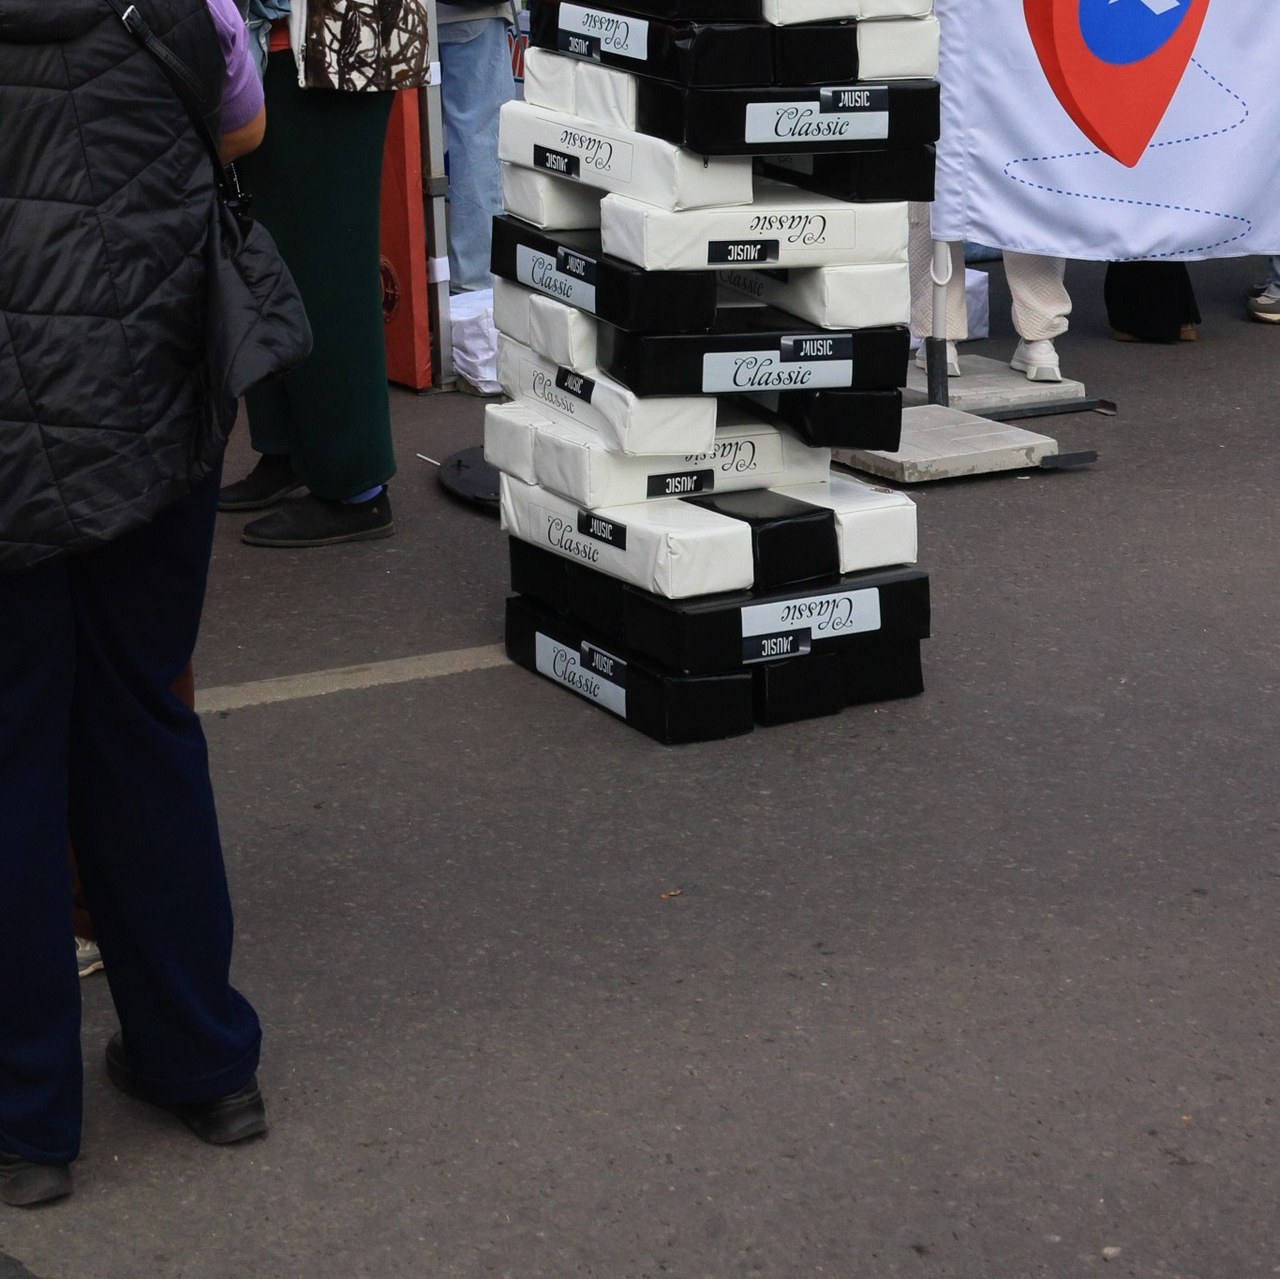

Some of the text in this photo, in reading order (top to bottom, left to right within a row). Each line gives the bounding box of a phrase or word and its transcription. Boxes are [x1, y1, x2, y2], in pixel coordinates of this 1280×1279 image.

[582, 13, 629, 50] Classic
[569, 38, 589, 55] MUSIC
[839, 91, 870, 107] MUSIC
[774, 107, 850, 137] Classic
[546, 153, 568, 172] MUSIC
[560, 130, 613, 171] Classic
[750, 214, 827, 245] Classic
[728, 245, 761, 260] MUSIC
[531, 255, 573, 298] Classic
[567, 255, 586, 276] MUSIC
[800, 340, 833, 356] MUSIC
[565, 374, 584, 394] MUSIC
[732, 357, 812, 387] Classic
[532, 370, 576, 414] Classic
[666, 476, 697, 493] MUSIC
[548, 515, 599, 563] Classic
[590, 518, 613, 540] MUSIC
[781, 596, 854, 631] Classic
[762, 635, 793, 656] MUSIC
[552, 646, 600, 698] Classic
[592, 651, 613, 676] MUSIC
